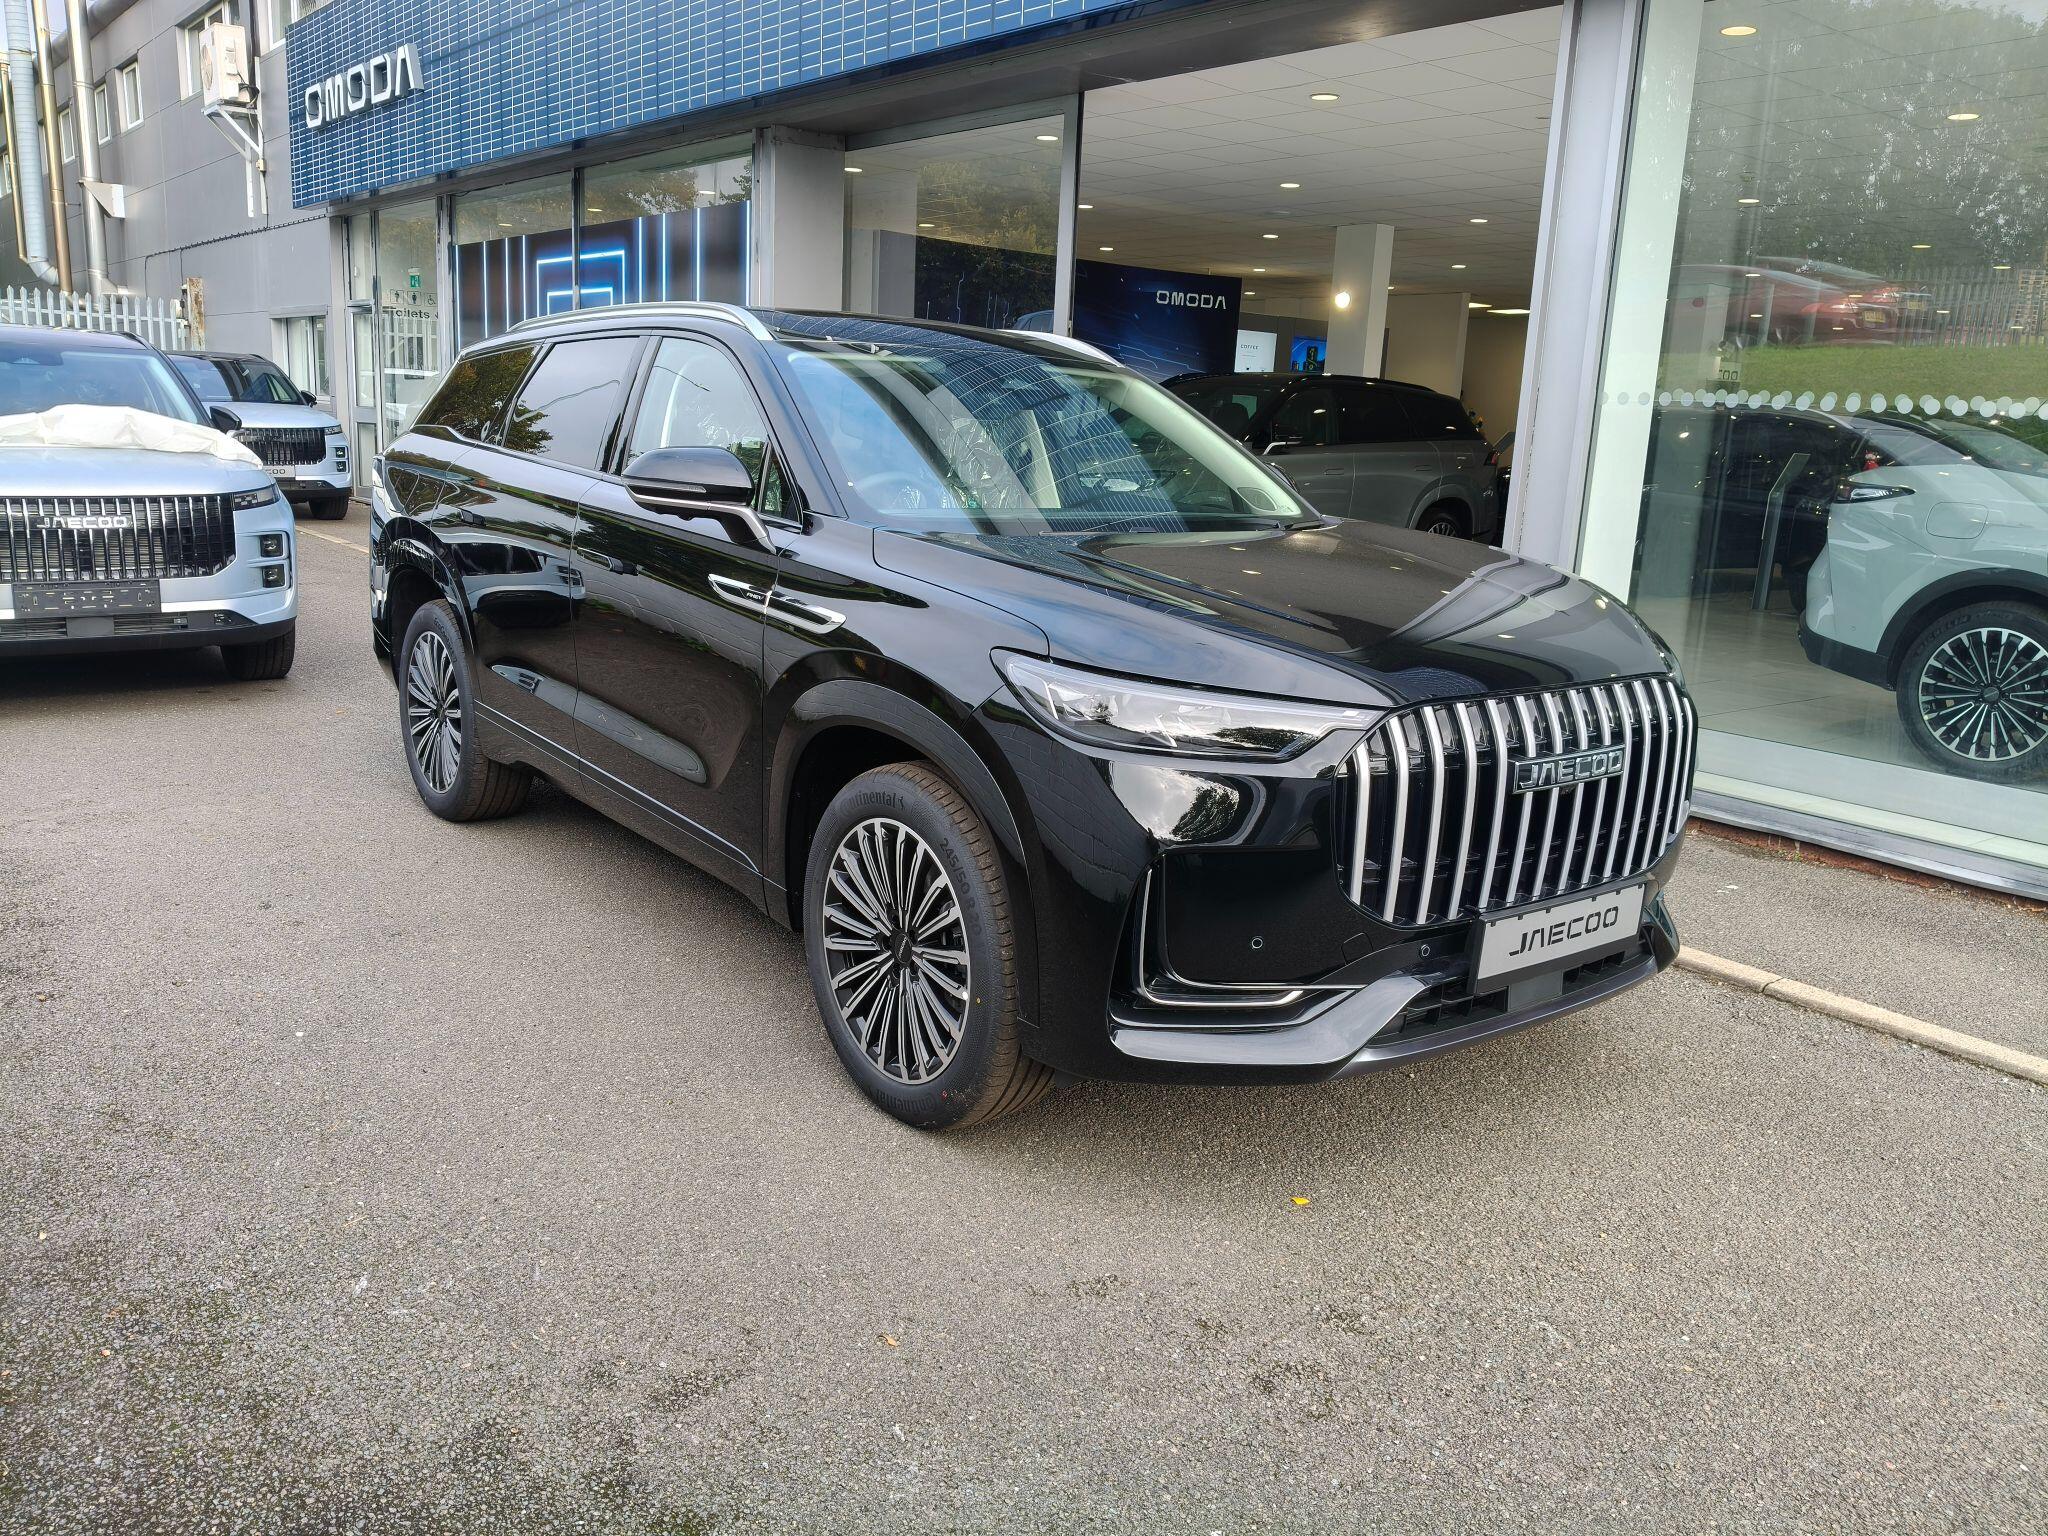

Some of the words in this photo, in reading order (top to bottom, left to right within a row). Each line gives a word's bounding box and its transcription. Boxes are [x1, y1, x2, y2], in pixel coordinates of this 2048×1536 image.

[305, 43, 420, 129] OMODA
[1155, 290, 1227, 310] OMODA
[36, 516, 128, 529] JAECOO
[1519, 750, 1624, 789] JAECOO
[1508, 905, 1619, 957] JAECOO
